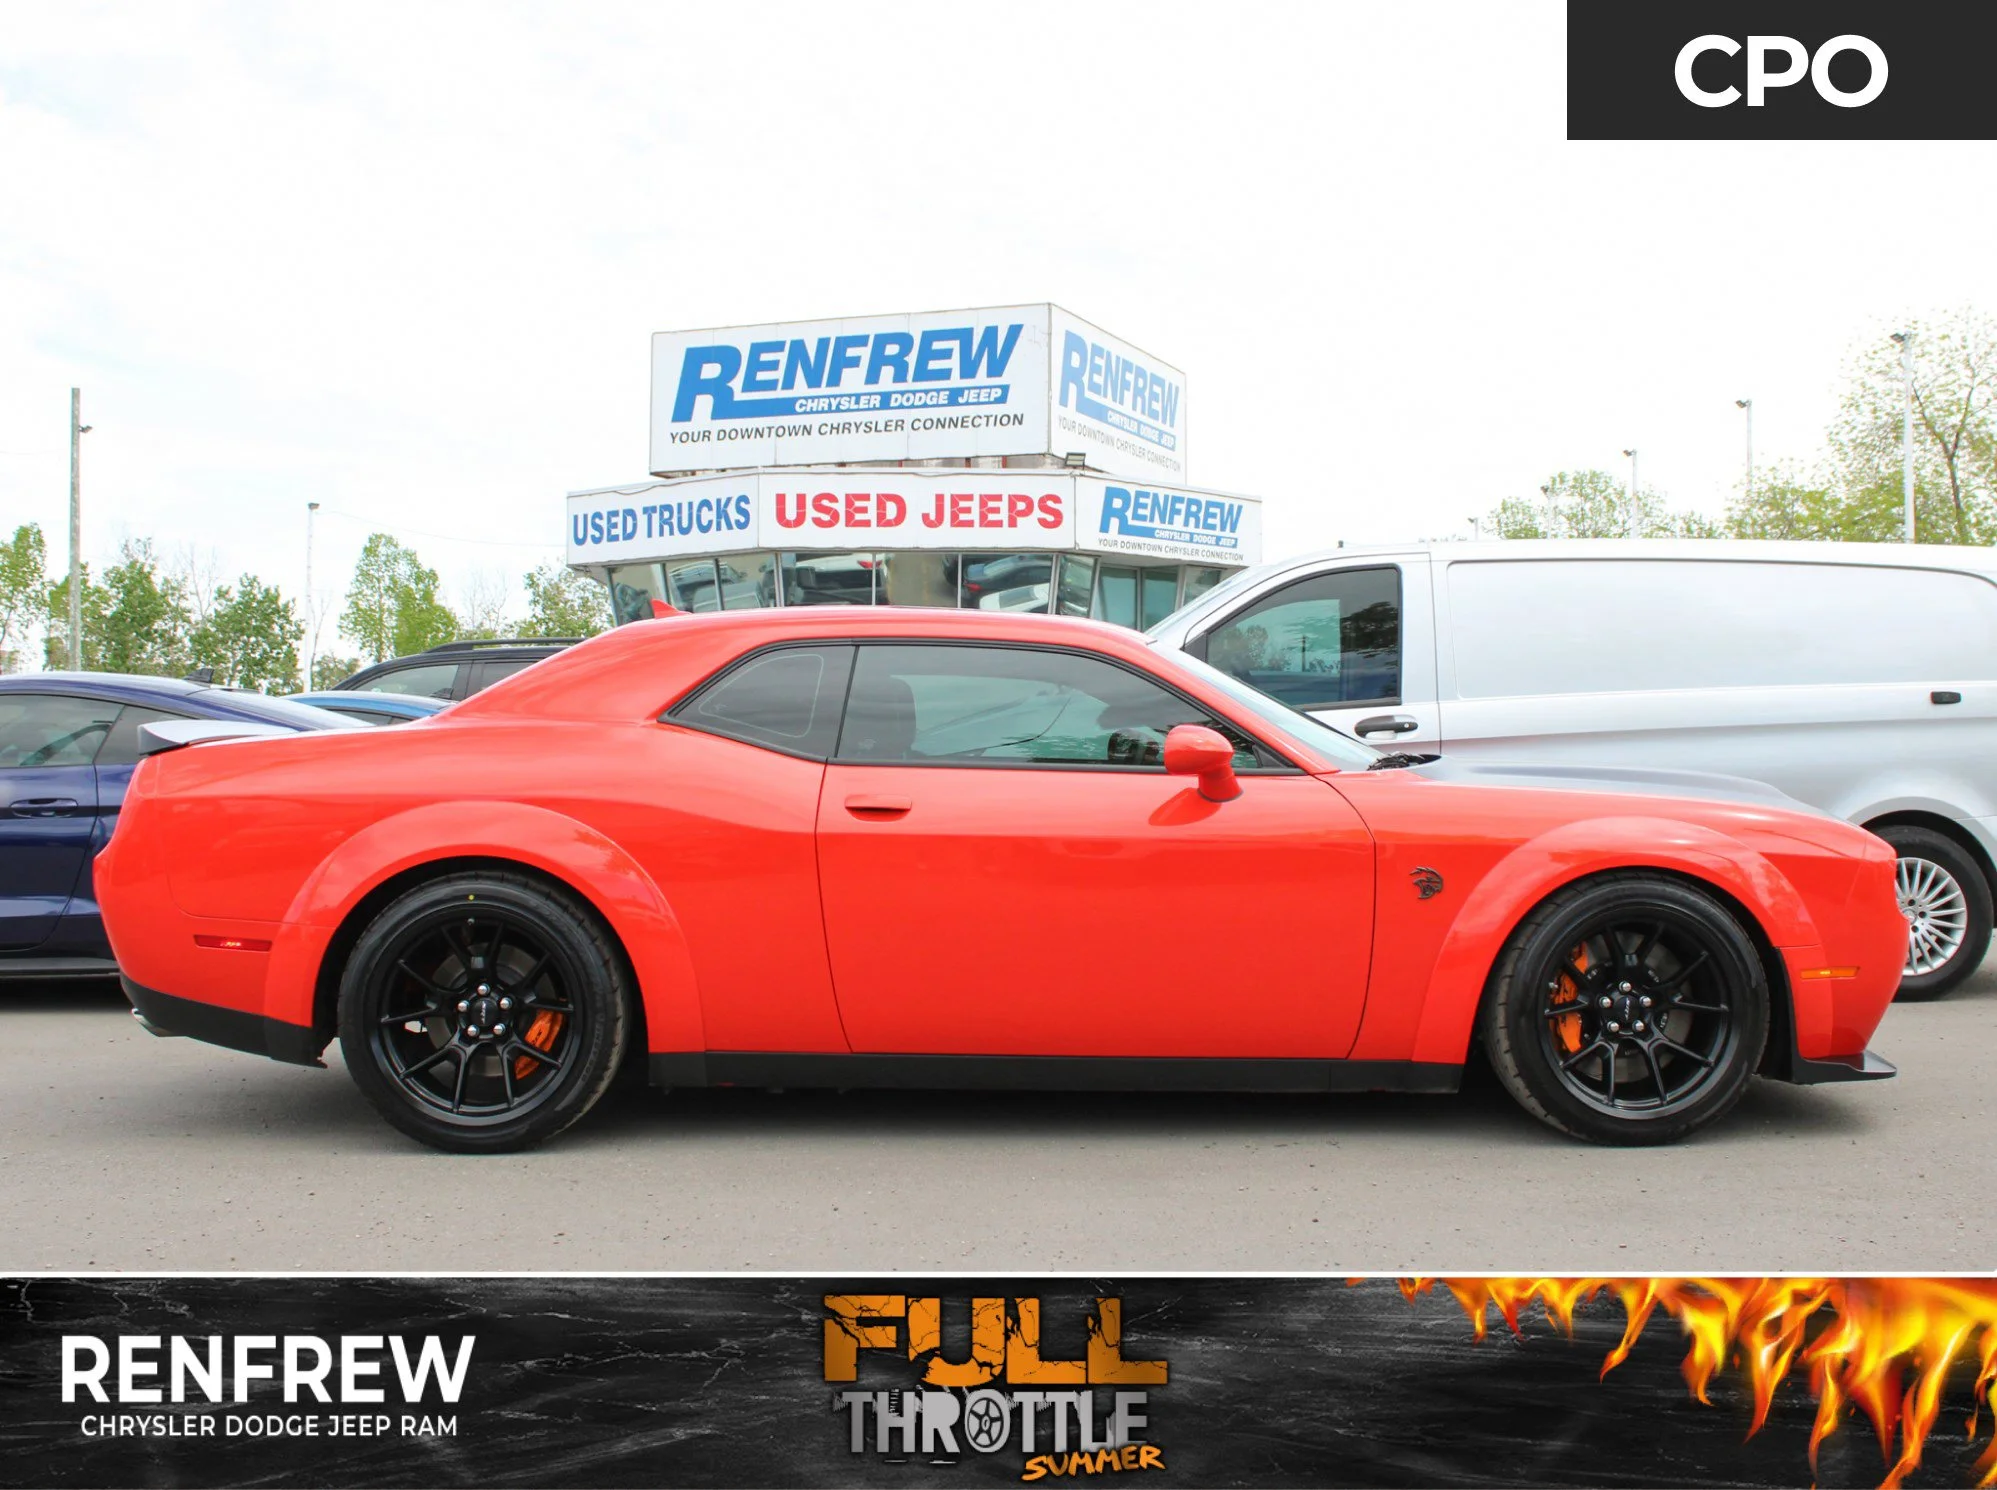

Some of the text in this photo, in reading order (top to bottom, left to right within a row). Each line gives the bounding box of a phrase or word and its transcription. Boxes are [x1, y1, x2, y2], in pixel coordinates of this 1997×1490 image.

[671, 324, 1024, 422] RENFREW
[1059, 329, 1179, 428] RENFREW
[795, 388, 1003, 413] CHRYSLER DODGE JEEP
[670, 413, 1024, 443] YOUR DOWNTOWN CHRYSLER CONNECTION
[1059, 415, 1181, 471] YOUR DOWNTOWN CHRYSLER CONNECTION
[573, 495, 751, 546] USED TRUCKS
[775, 493, 1064, 529] USED JEEPS
[1099, 486, 1243, 533] RENFREW
[1098, 538, 1244, 561] YOUR DOWNTOWN CHRYSLER CONNECTION
[1155, 529, 1235, 547] CHRYSLER DODGE JEEP
